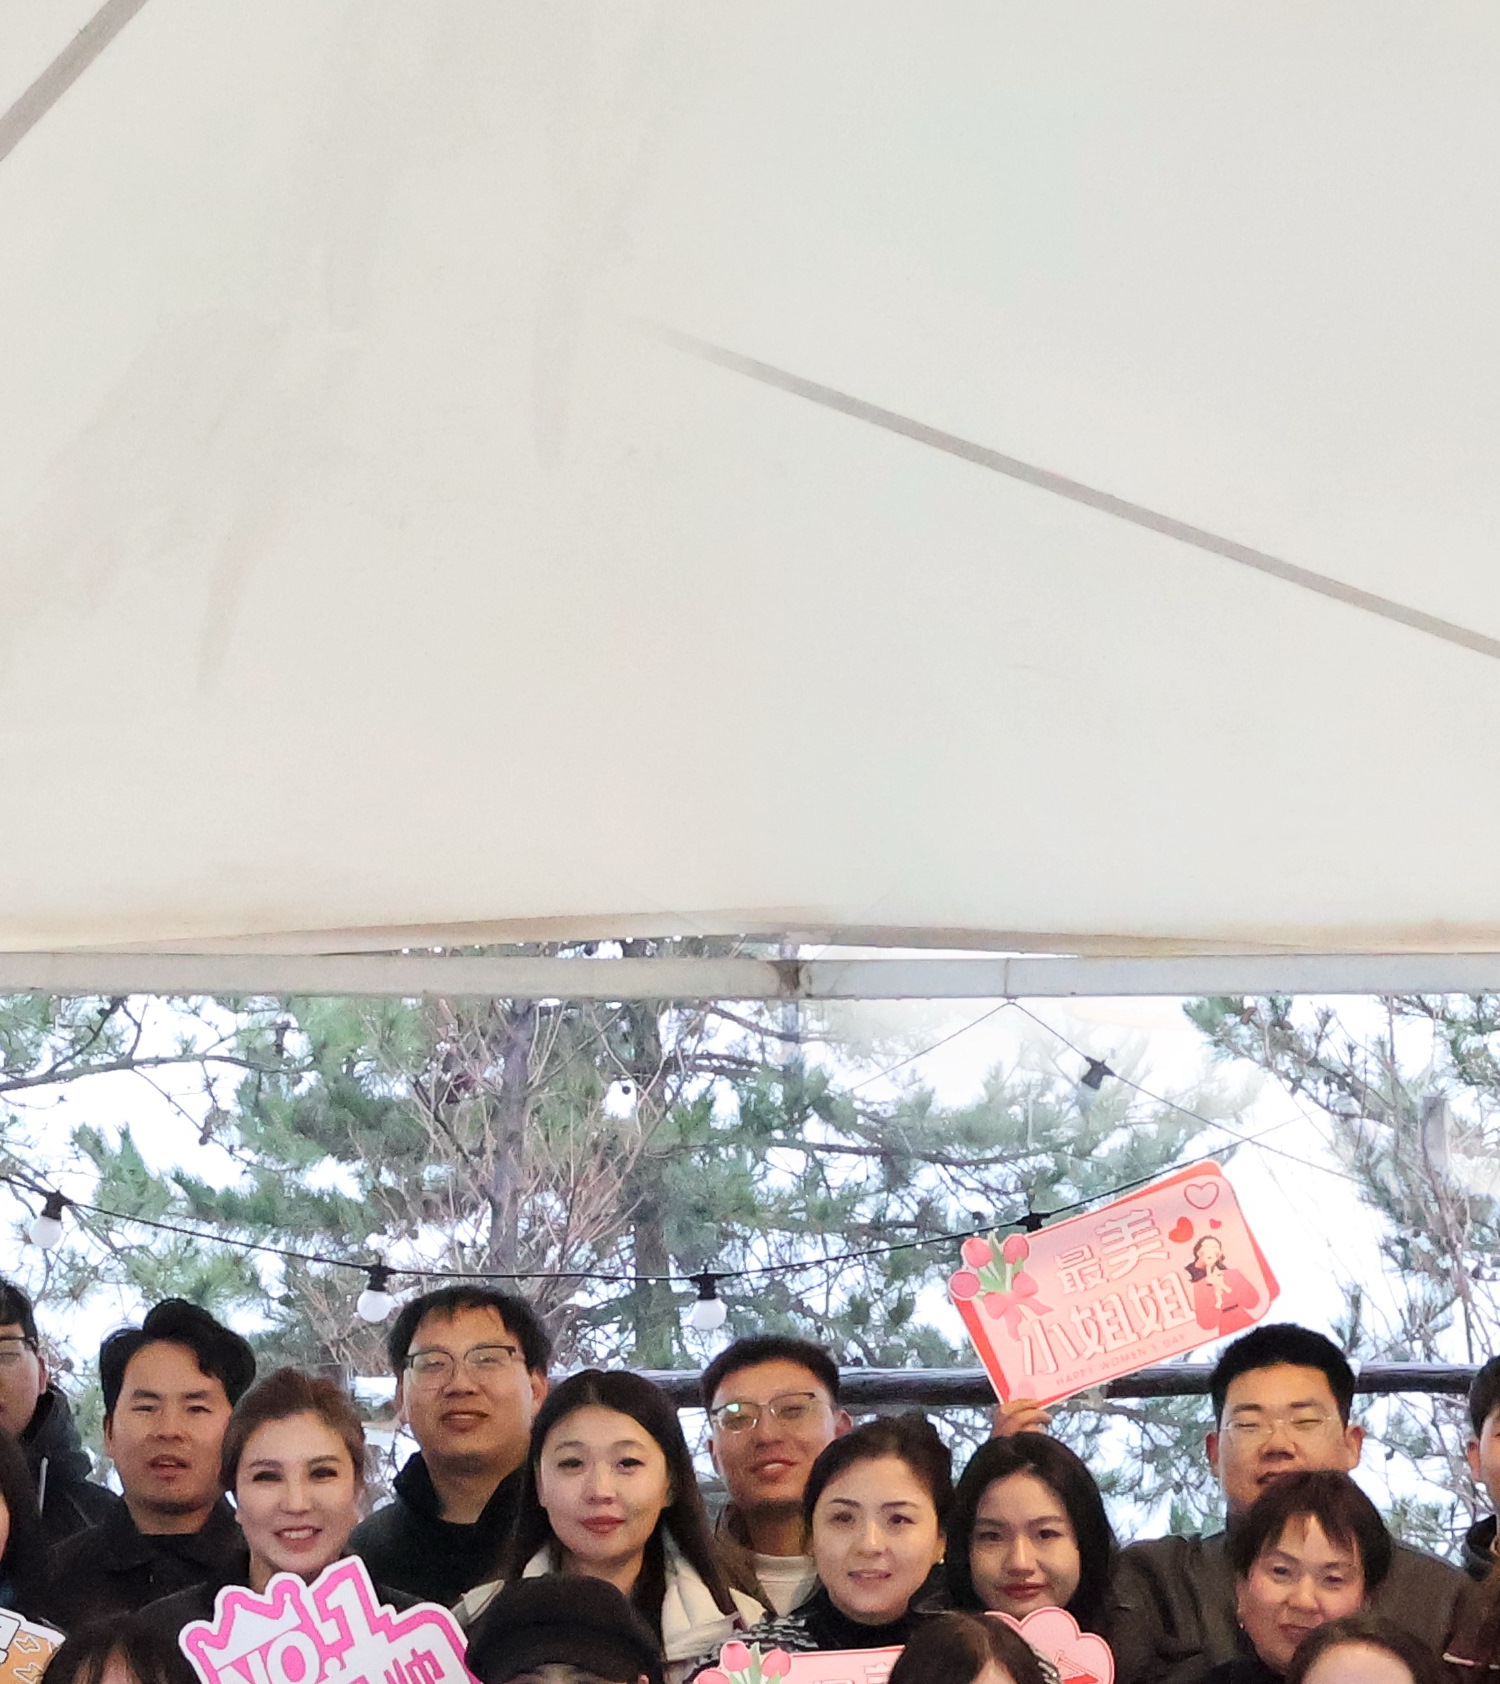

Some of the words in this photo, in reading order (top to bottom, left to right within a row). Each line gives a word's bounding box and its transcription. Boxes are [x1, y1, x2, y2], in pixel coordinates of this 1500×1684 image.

[1054, 1207, 1170, 1294] 最美
[1018, 1271, 1197, 1376] 小姐姐
